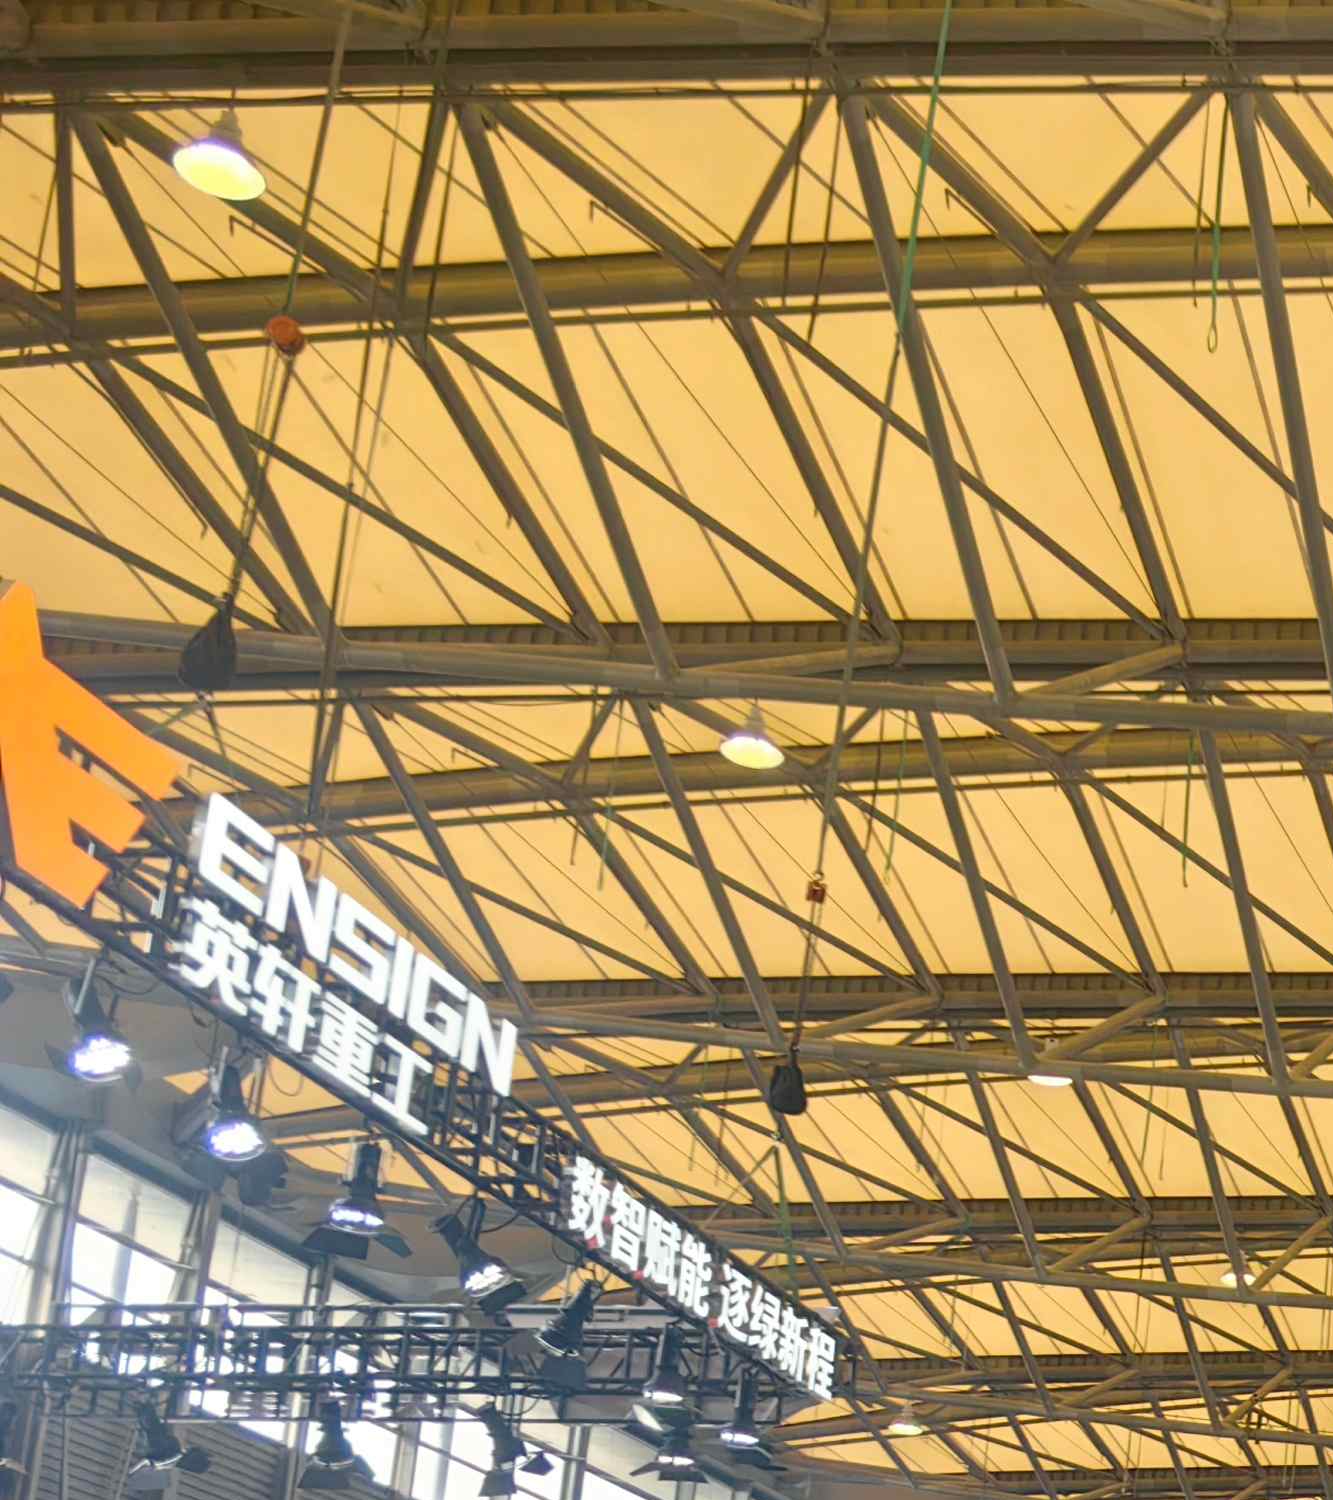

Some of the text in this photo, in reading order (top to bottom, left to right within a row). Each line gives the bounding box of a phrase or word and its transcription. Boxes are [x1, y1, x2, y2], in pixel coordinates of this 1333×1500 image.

[170, 897, 434, 1136] 英轩重工
[199, 792, 518, 1097] ENSIGN
[567, 1156, 837, 1400] 数智赋能 逐绿新程
